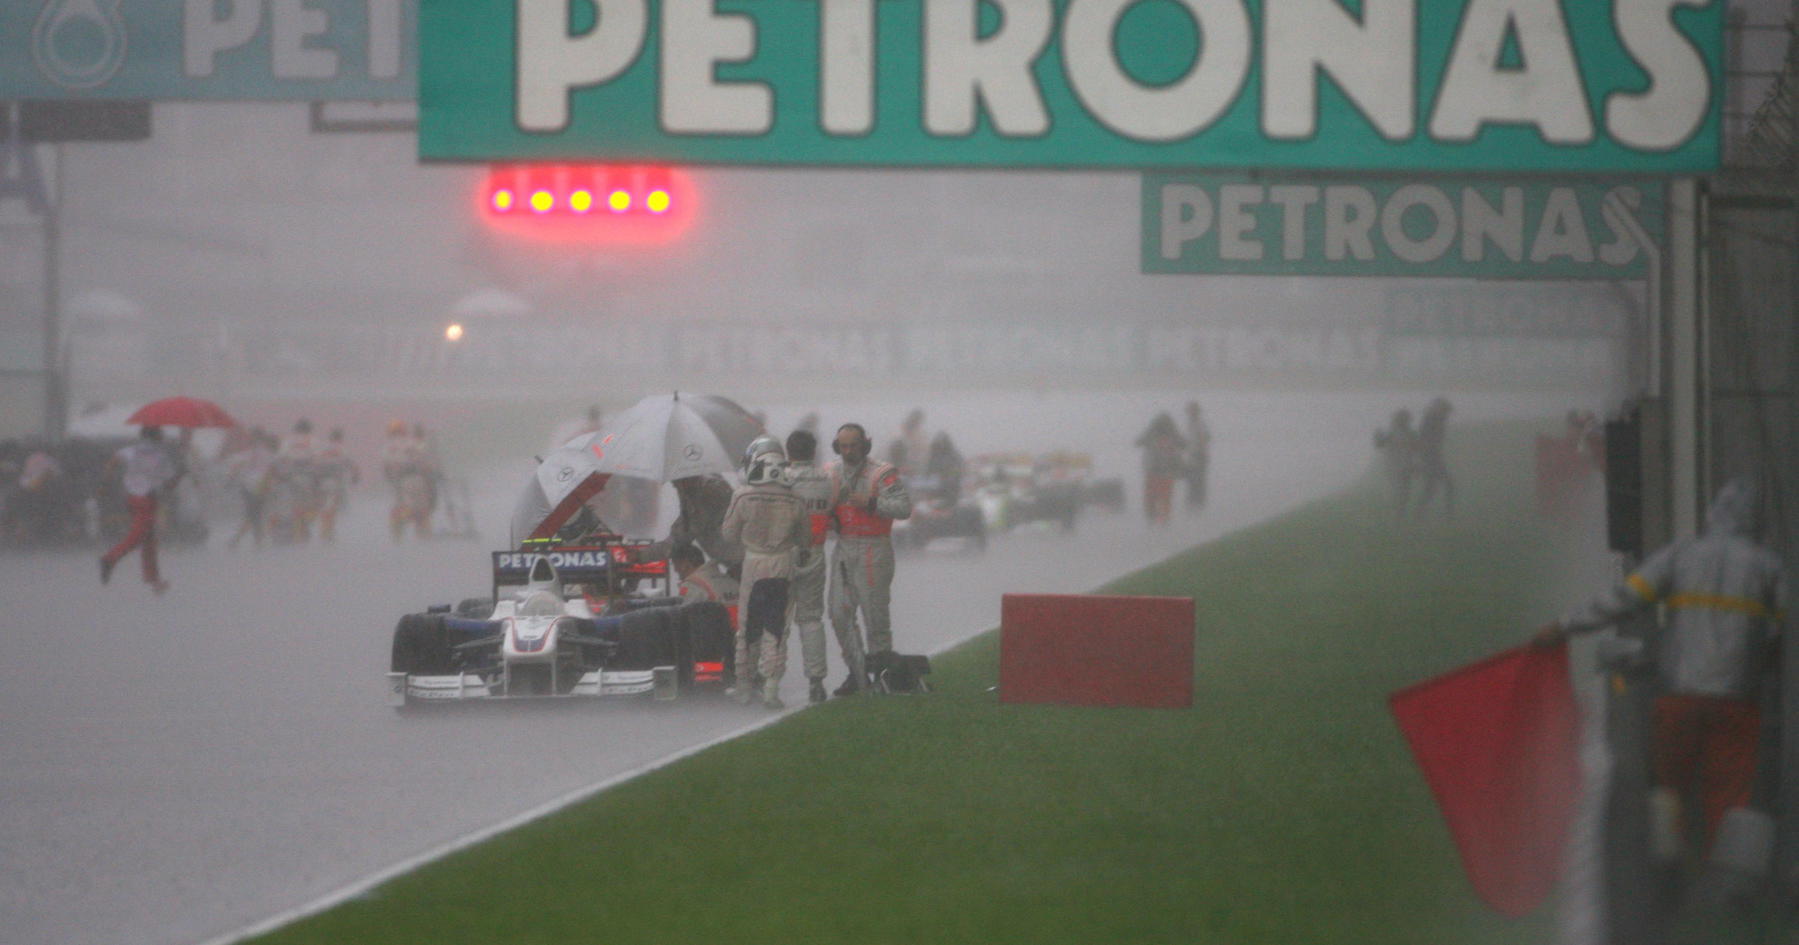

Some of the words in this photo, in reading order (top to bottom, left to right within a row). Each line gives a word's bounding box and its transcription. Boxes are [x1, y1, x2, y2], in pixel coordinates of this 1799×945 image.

[515, 0, 1712, 149] PETRONAS
[1160, 184, 1642, 264] PETRONAS
[499, 551, 606, 568] PETONAS
